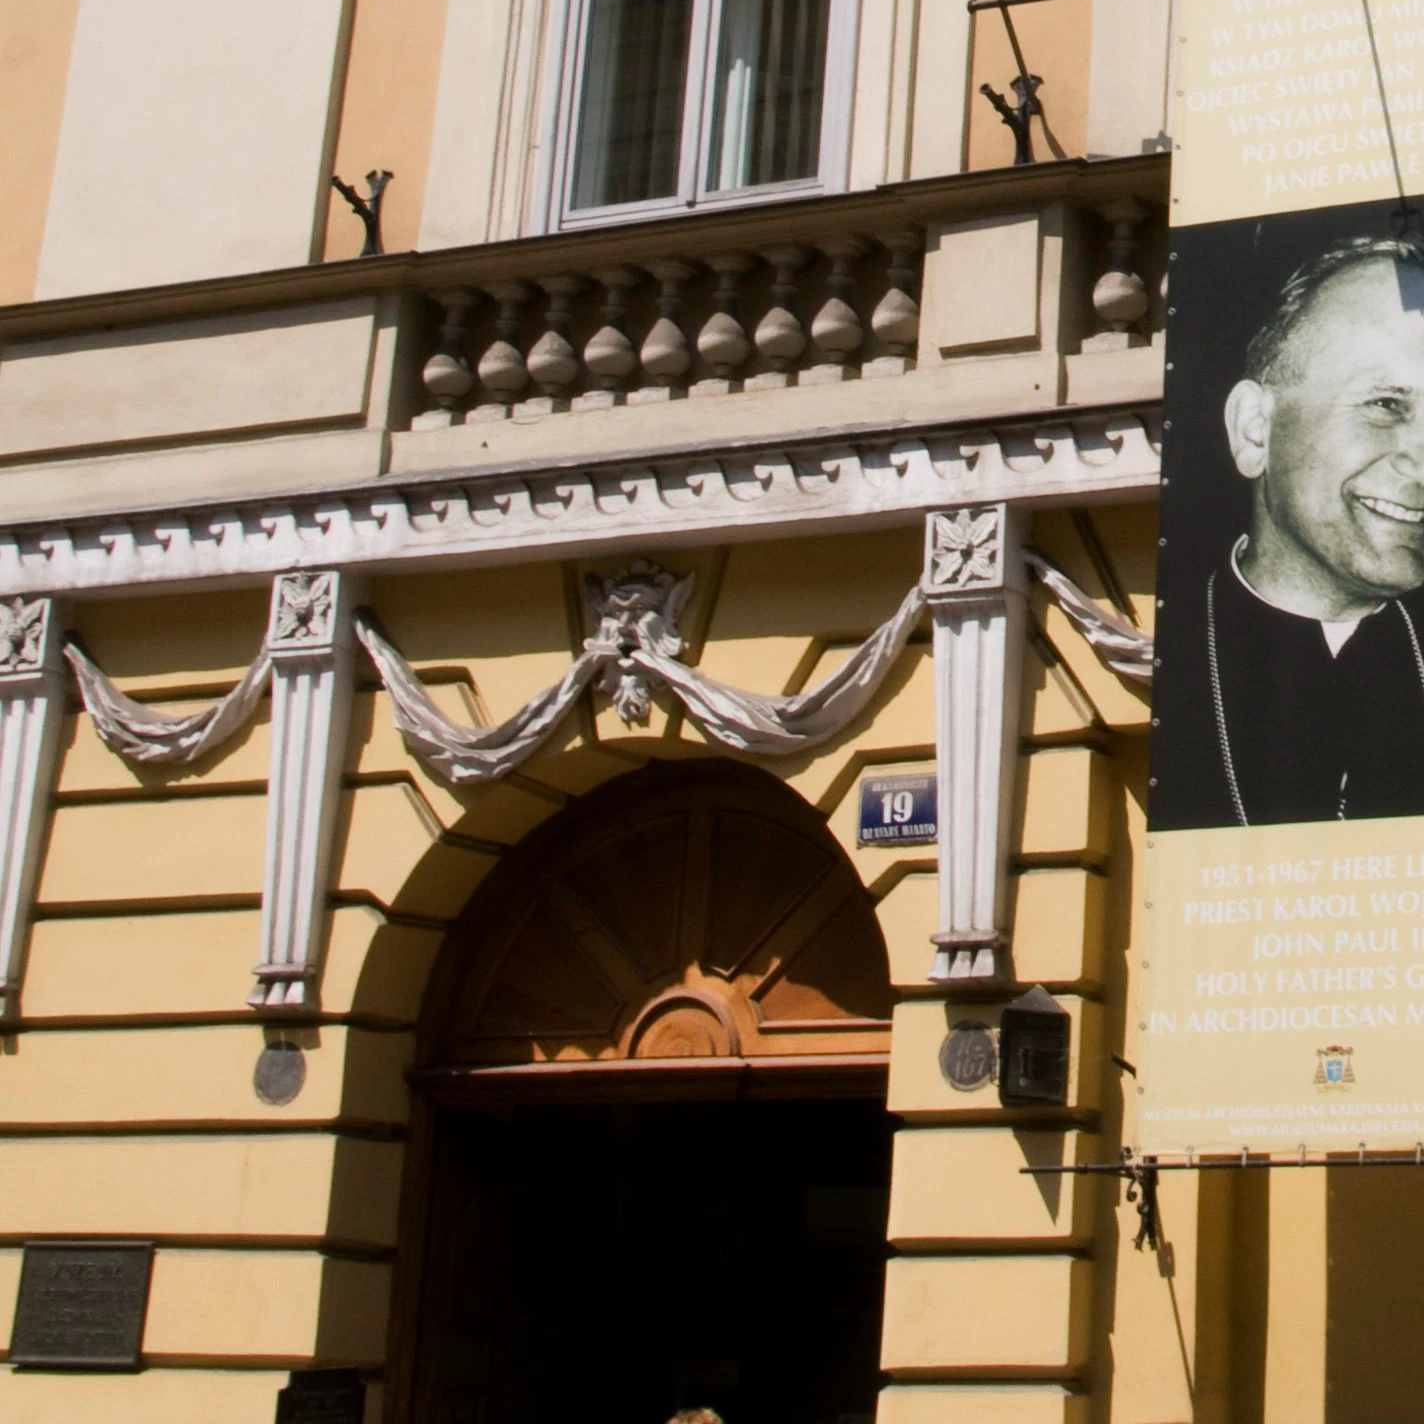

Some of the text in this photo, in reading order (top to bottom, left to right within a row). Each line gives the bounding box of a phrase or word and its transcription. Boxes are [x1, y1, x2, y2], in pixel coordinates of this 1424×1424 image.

[1212, 26, 1236, 47] W
[1245, 18, 1293, 43] TYM
[1301, 4, 1383, 34] DOMU
[1305, 35, 1384, 64] KAROL
[1186, 81, 1269, 112] OJCIEC
[1371, 62, 1416, 88] JAN
[1229, 101, 1354, 136] WYSTAWA
[1242, 143, 1277, 165] PO
[1283, 132, 1349, 161] OJCU
[1264, 165, 1329, 199] JANIE
[882, 791, 914, 823] 19
[1200, 860, 1325, 889] 1951-1967
[1331, 854, 1397, 881] HERE
[1183, 897, 1265, 926] PRIEST
[1273, 893, 1361, 921] KAROL
[1252, 932, 1325, 962] JOHN
[1334, 928, 1404, 953] PAUL
[1195, 970, 1268, 998] HOLY
[1275, 965, 1397, 994] FATHER'S
[1149, 1011, 1177, 1036] IN
[1184, 1001, 1397, 1035] ARCHDIOCESAN
